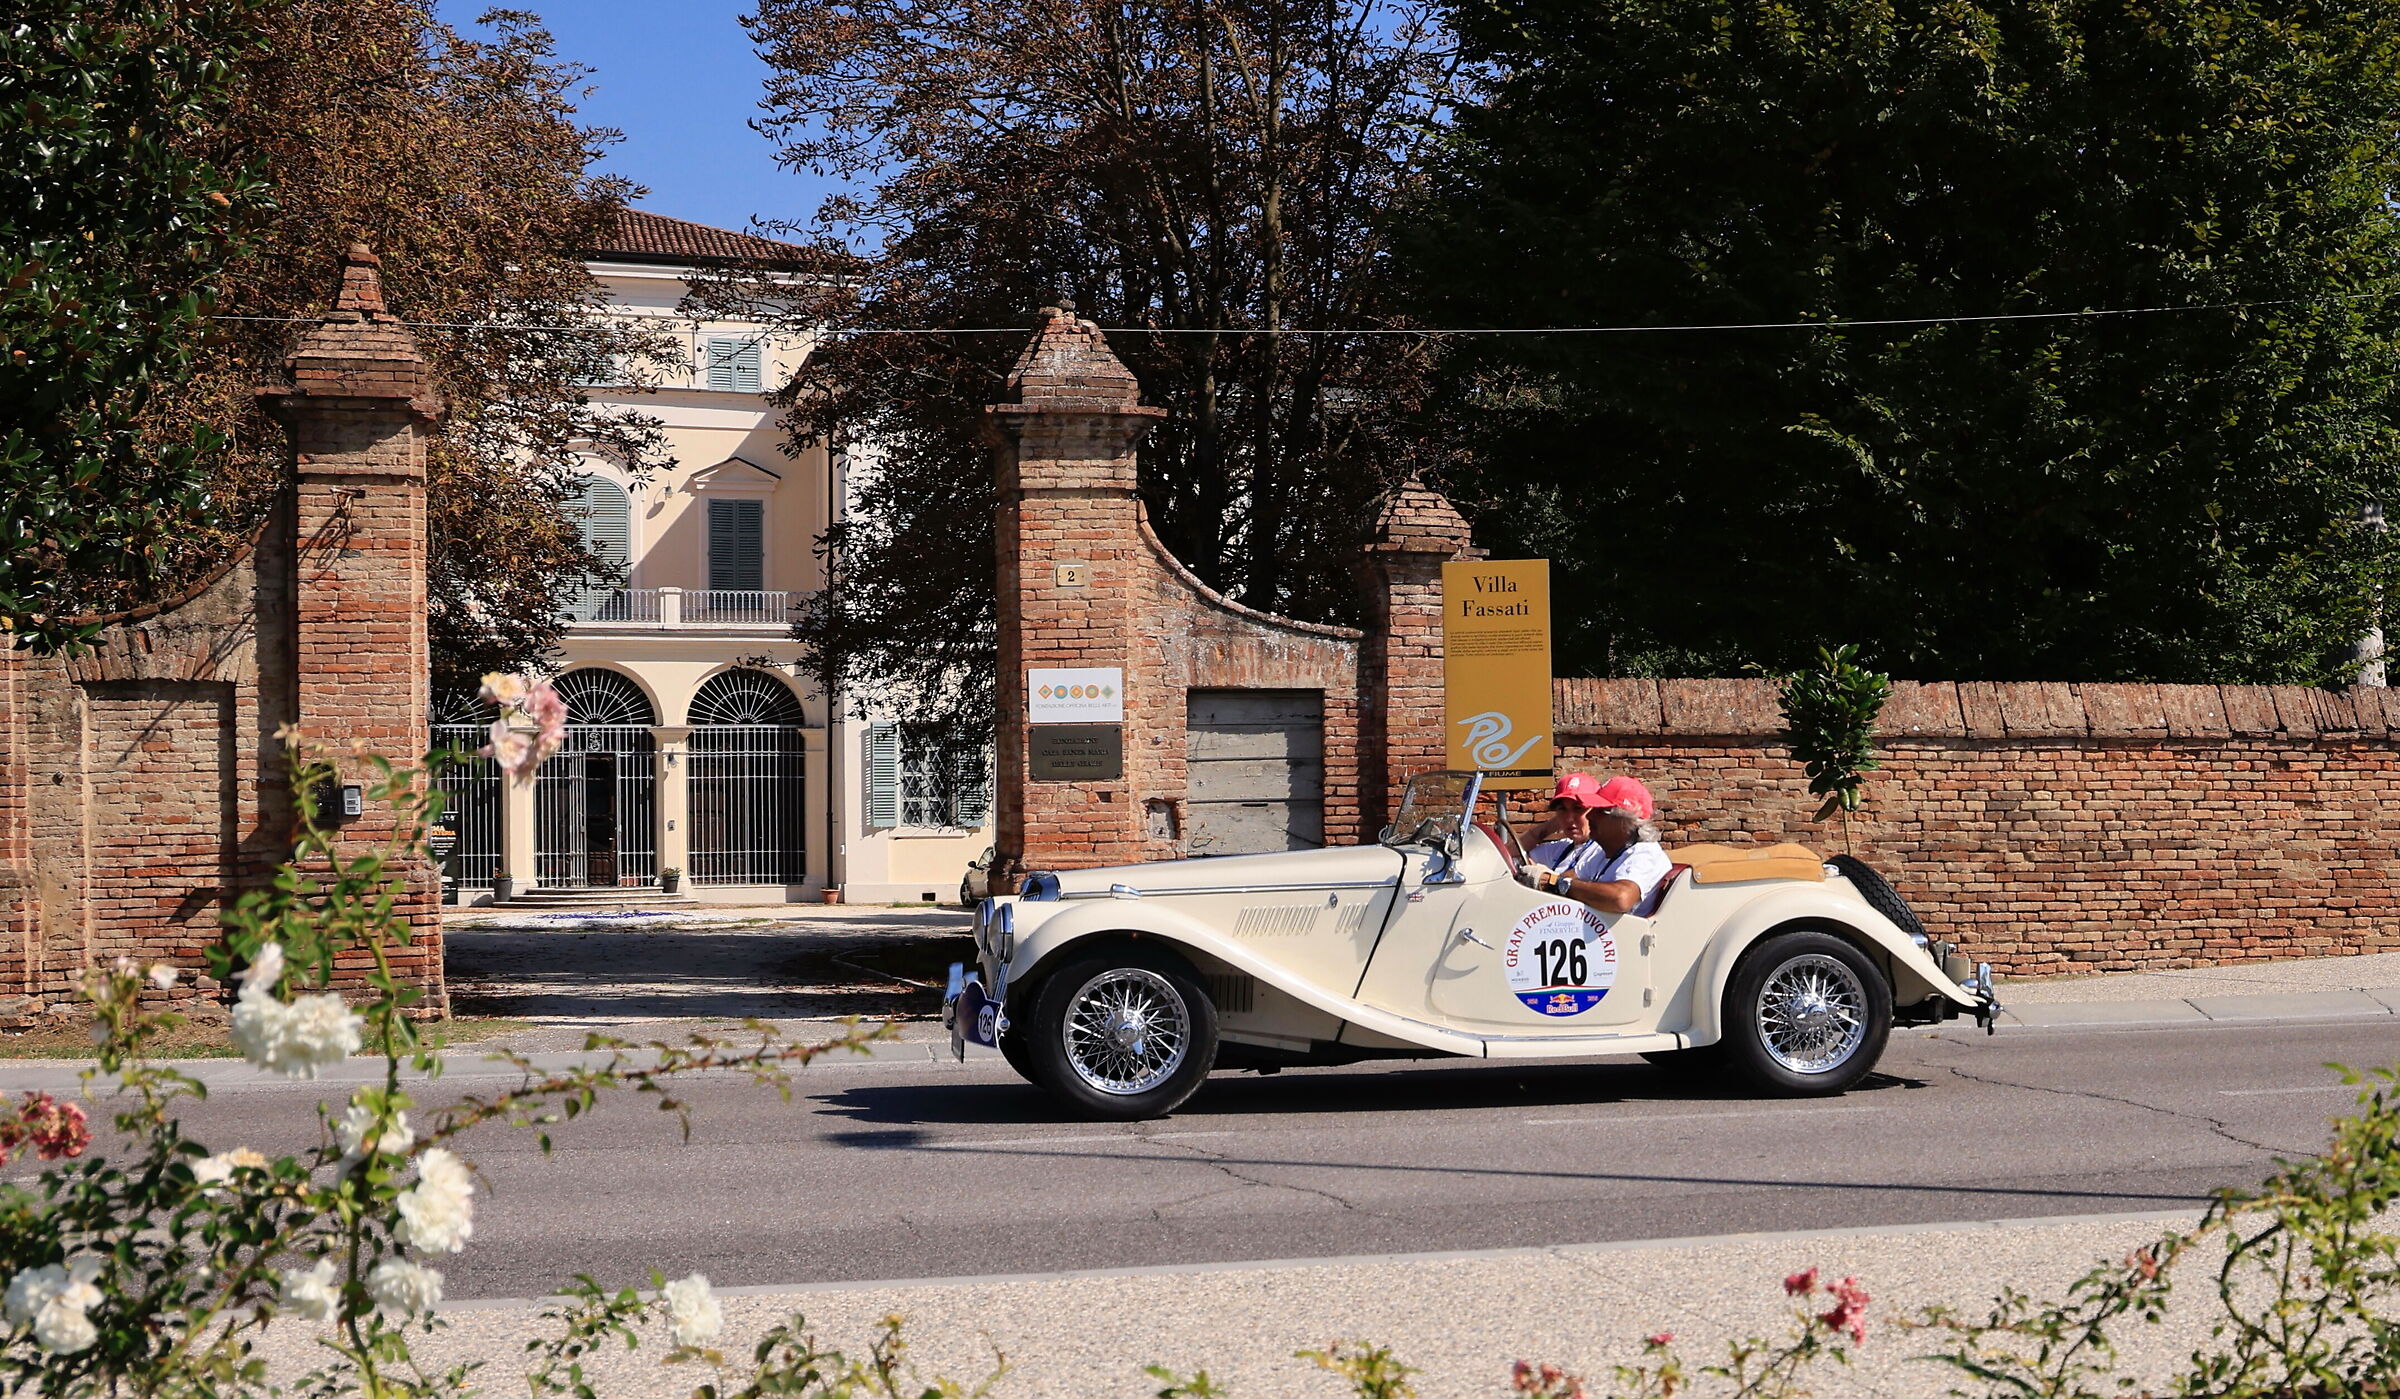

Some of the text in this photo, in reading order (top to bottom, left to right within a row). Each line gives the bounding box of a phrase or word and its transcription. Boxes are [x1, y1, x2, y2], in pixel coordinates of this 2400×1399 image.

[1067, 570, 1076, 582] 2
[1472, 576, 1518, 593] Villa
[1462, 599, 1529, 617] Fassati
[1506, 904, 1616, 968] GRAN PREMIO NUVOLARI
[1534, 937, 1588, 987] 126
[979, 1013, 993, 1036] 126
